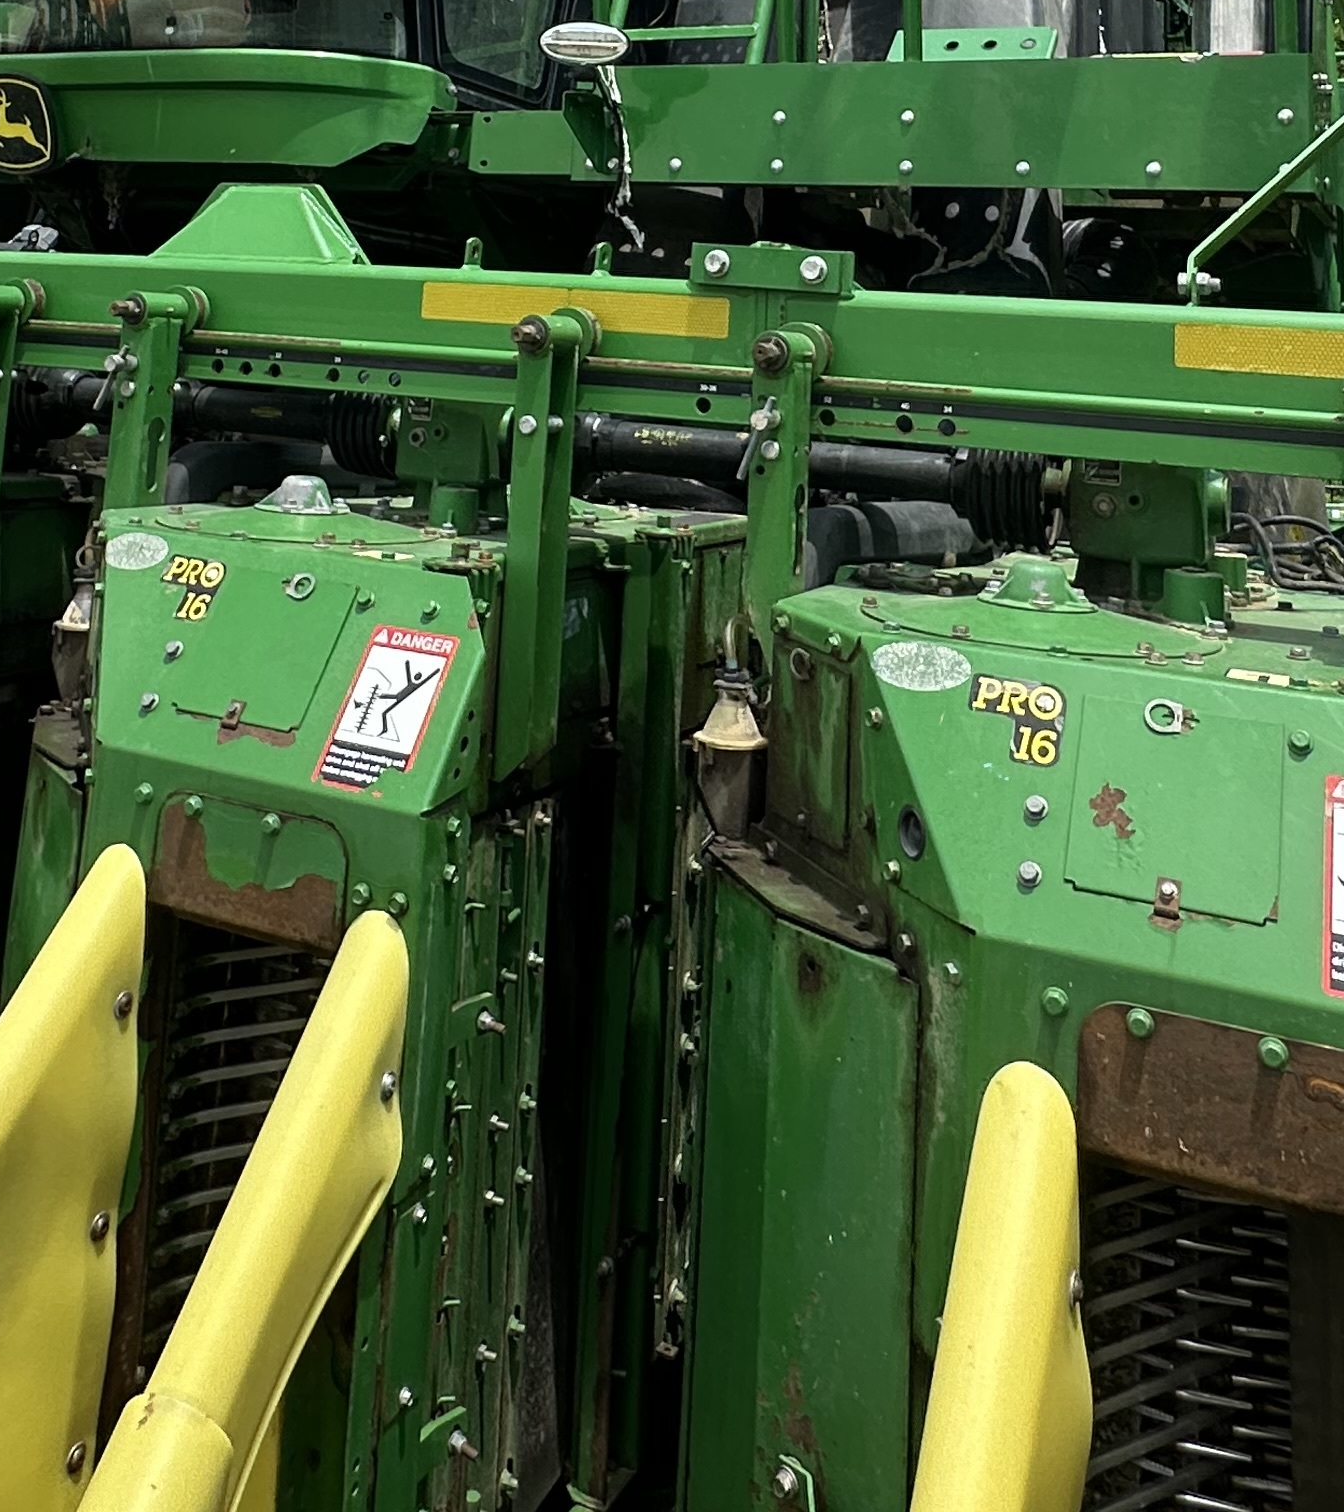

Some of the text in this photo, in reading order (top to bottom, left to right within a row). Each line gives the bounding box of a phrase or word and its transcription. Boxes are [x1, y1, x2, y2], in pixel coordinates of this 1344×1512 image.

[162, 556, 225, 588] PRO
[176, 591, 212, 620] 16
[389, 631, 454, 655] DANGER
[971, 676, 1063, 721] PRO
[1013, 726, 1058, 764] 16
